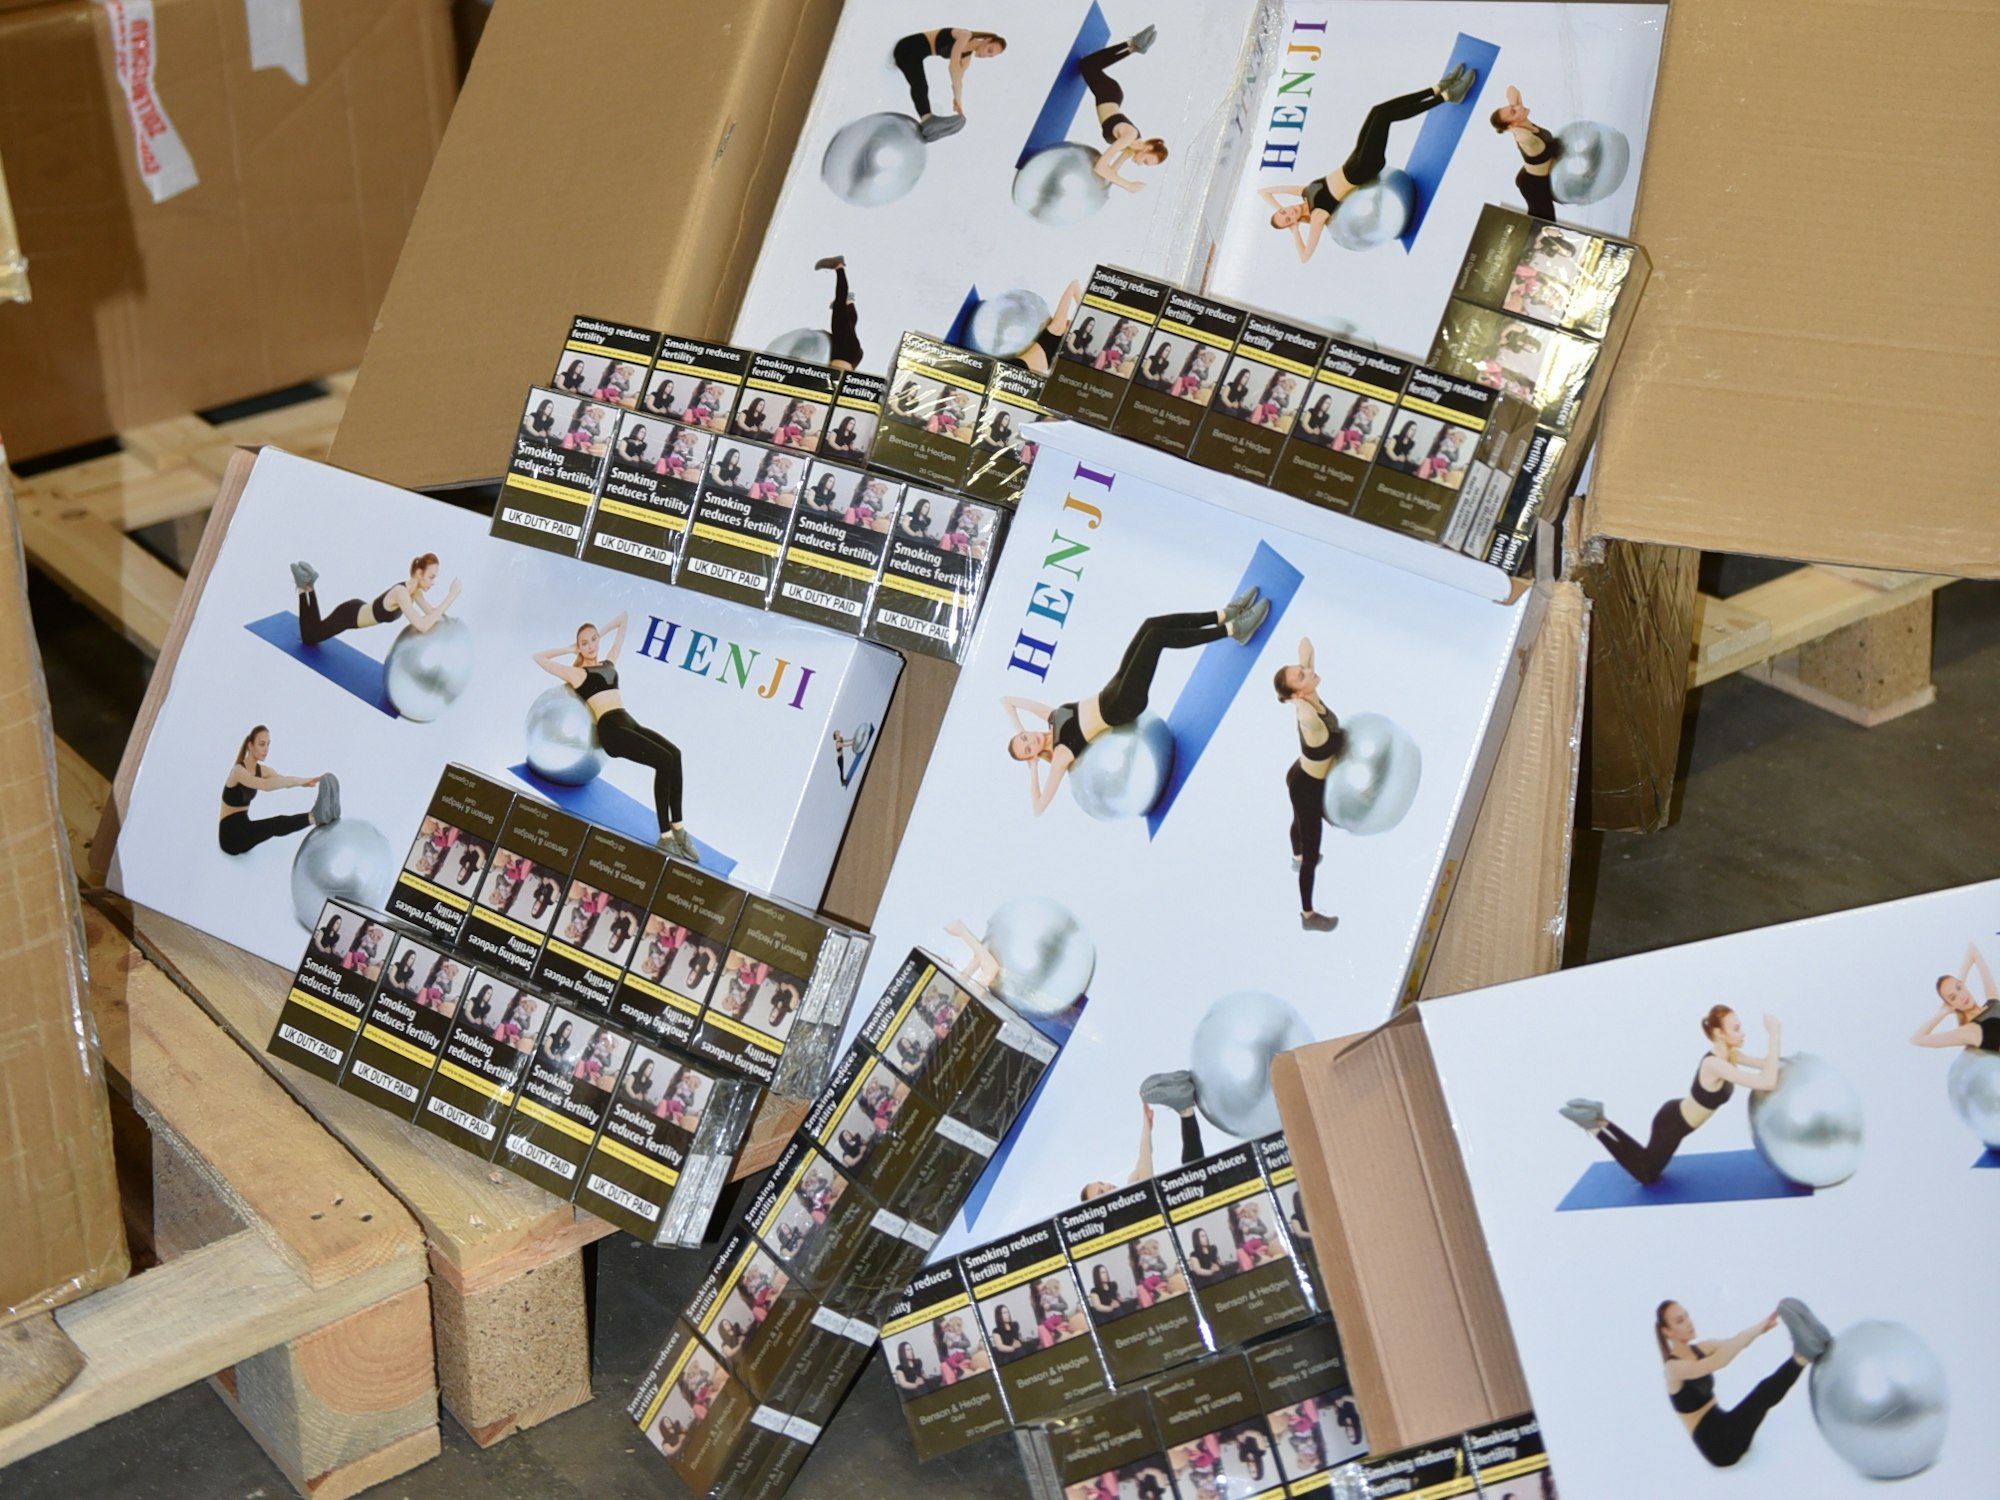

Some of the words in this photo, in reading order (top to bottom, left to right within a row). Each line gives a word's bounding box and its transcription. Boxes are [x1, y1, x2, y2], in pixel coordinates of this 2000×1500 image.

[1259, 20, 1328, 172] HENJI
[1090, 282, 1118, 300] fertility
[1095, 270, 1127, 290] Smoking
[1129, 281, 1159, 298] reduces
[1165, 306, 1195, 324] fertility
[1170, 295, 1204, 314] Smoking
[1206, 306, 1237, 324] reduces
[572, 330, 605, 344] fertility
[575, 319, 614, 336] Smoking
[616, 328, 650, 343] reduces
[1243, 332, 1274, 350] fertility
[1248, 319, 1284, 340] Smoking
[1284, 332, 1318, 349] reduces
[661, 349, 696, 364] fertility
[665, 338, 704, 355] Smoking
[706, 348, 740, 362] reduces
[1330, 344, 1366, 365] Smoking
[1367, 356, 1402, 375] reduces
[752, 368, 785, 382] fertility
[755, 357, 794, 374] Smoking
[796, 366, 831, 380] reduces
[1324, 358, 1357, 376] fertility
[842, 384, 876, 400] fertility
[1408, 383, 1442, 402] fertility
[1414, 369, 1453, 390] Smoking
[1454, 381, 1488, 400] reduces
[519, 442, 565, 464] Smoking
[889, 434, 917, 450] Benson
[926, 446, 956, 462] Hedges
[1522, 436, 1548, 473] fertility
[514, 457, 554, 476] reduces
[557, 468, 596, 488] fertility
[611, 468, 657, 489] Smoking
[607, 483, 648, 502] reduces
[650, 492, 690, 514] fertility
[704, 492, 751, 514] Smoking
[1377, 483, 1402, 498] Benson
[1412, 493, 1441, 511] Hedges
[508, 511, 523, 522] UK
[524, 514, 551, 530] DUTY
[552, 522, 574, 536] PAID
[700, 507, 740, 528] reduces
[743, 518, 784, 540] fertility
[799, 516, 846, 539] Smoking
[602, 536, 615, 547] UK
[617, 539, 643, 556] DUTY
[644, 546, 666, 562] PAID
[795, 532, 836, 552] reduces
[838, 543, 879, 565] fertility
[894, 543, 942, 566] Smoking
[694, 560, 708, 572] UK
[710, 564, 736, 582] DUTY
[738, 572, 760, 587] PAID
[890, 559, 932, 579] reduces
[1007, 460, 1116, 683] HENJI
[788, 585, 802, 597] UK
[804, 589, 832, 606] DUTY
[833, 598, 855, 614] PAID
[884, 612, 898, 624] UK
[900, 616, 928, 632] DUTY
[636, 615, 816, 710] HENJI
[395, 900, 426, 921] reduces
[434, 902, 462, 923] fertility
[426, 914, 457, 937] Smoking
[468, 935, 500, 954] reduces
[508, 936, 537, 958] fertility
[304, 957, 342, 985] Smoking
[500, 949, 532, 971] Smoking
[543, 968, 573, 988] reduces
[583, 970, 614, 991] fertility
[299, 974, 330, 996] reduces
[332, 989, 365, 1014] fertility
[378, 993, 416, 1021] Smoking
[573, 983, 610, 1007] Smoking
[862, 1000, 890, 1038] Smoking
[890, 959, 915, 997] reduces
[620, 1004, 651, 1023] reduces
[663, 1006, 694, 1027] fertility
[870, 1008, 894, 1044] fertility
[372, 1009, 405, 1032] reduces
[406, 1024, 440, 1049] fertility
[453, 1028, 494, 1057] Smoking
[652, 1019, 689, 1042] Smoking
[284, 1027, 297, 1038] UK
[298, 1032, 319, 1050] DUTY
[318, 1044, 336, 1061] PAID
[701, 1040, 734, 1061] reduces
[746, 1044, 777, 1067] fertility
[448, 1044, 480, 1068] reduces
[482, 1060, 518, 1086] fertility
[735, 1056, 772, 1082] Smoking
[358, 1064, 370, 1076] UK
[371, 1070, 393, 1088] DUTY
[393, 1080, 412, 1098] PAID
[533, 1066, 573, 1094] Smoking
[804, 1090, 834, 1130] Smoking
[833, 1051, 857, 1088] reduces
[526, 1081, 561, 1106] reduces
[563, 1098, 599, 1125] fertility
[433, 1100, 446, 1112] UK
[447, 1106, 470, 1127] DUTY
[470, 1116, 490, 1135] PAID
[615, 1104, 656, 1132] Smoking
[810, 1100, 837, 1137] fertility
[511, 1136, 526, 1150] UK
[526, 1143, 551, 1164] DUTY
[550, 1155, 570, 1174] PAID
[608, 1120, 644, 1145] reduces
[645, 1136, 682, 1165] fertility
[744, 1182, 775, 1223] Smoking
[773, 1143, 798, 1180] reduces
[1162, 1168, 1206, 1192] Smoking
[1208, 1153, 1247, 1175] reduces
[594, 1176, 609, 1190] UK
[610, 1183, 633, 1204] DUTY
[633, 1196, 652, 1216] PAID
[1062, 1205, 1106, 1228] Smoking
[1108, 1189, 1147, 1212] reduces
[1166, 1185, 1204, 1206] fertility
[752, 1192, 777, 1230] fertility
[1068, 1222, 1104, 1243] fertility
[966, 1246, 1009, 1268] Smoking
[1010, 1229, 1049, 1251] reduces
[686, 1275, 716, 1318] Smoking
[714, 1236, 740, 1273] reduces
[912, 1269, 952, 1292] reduces
[970, 1262, 1007, 1282] fertility
[692, 1286, 718, 1324] fertility
[627, 1371, 657, 1414] Smoking
[654, 1331, 680, 1370] reduces
[1017, 1370, 1048, 1389] Benson
[1057, 1355, 1089, 1373] Hedges
[633, 1382, 659, 1422] fertility
[1471, 1428, 1519, 1448] Smoking
[1415, 1448, 1456, 1465] reduces
[1475, 1448, 1517, 1466] fertility
